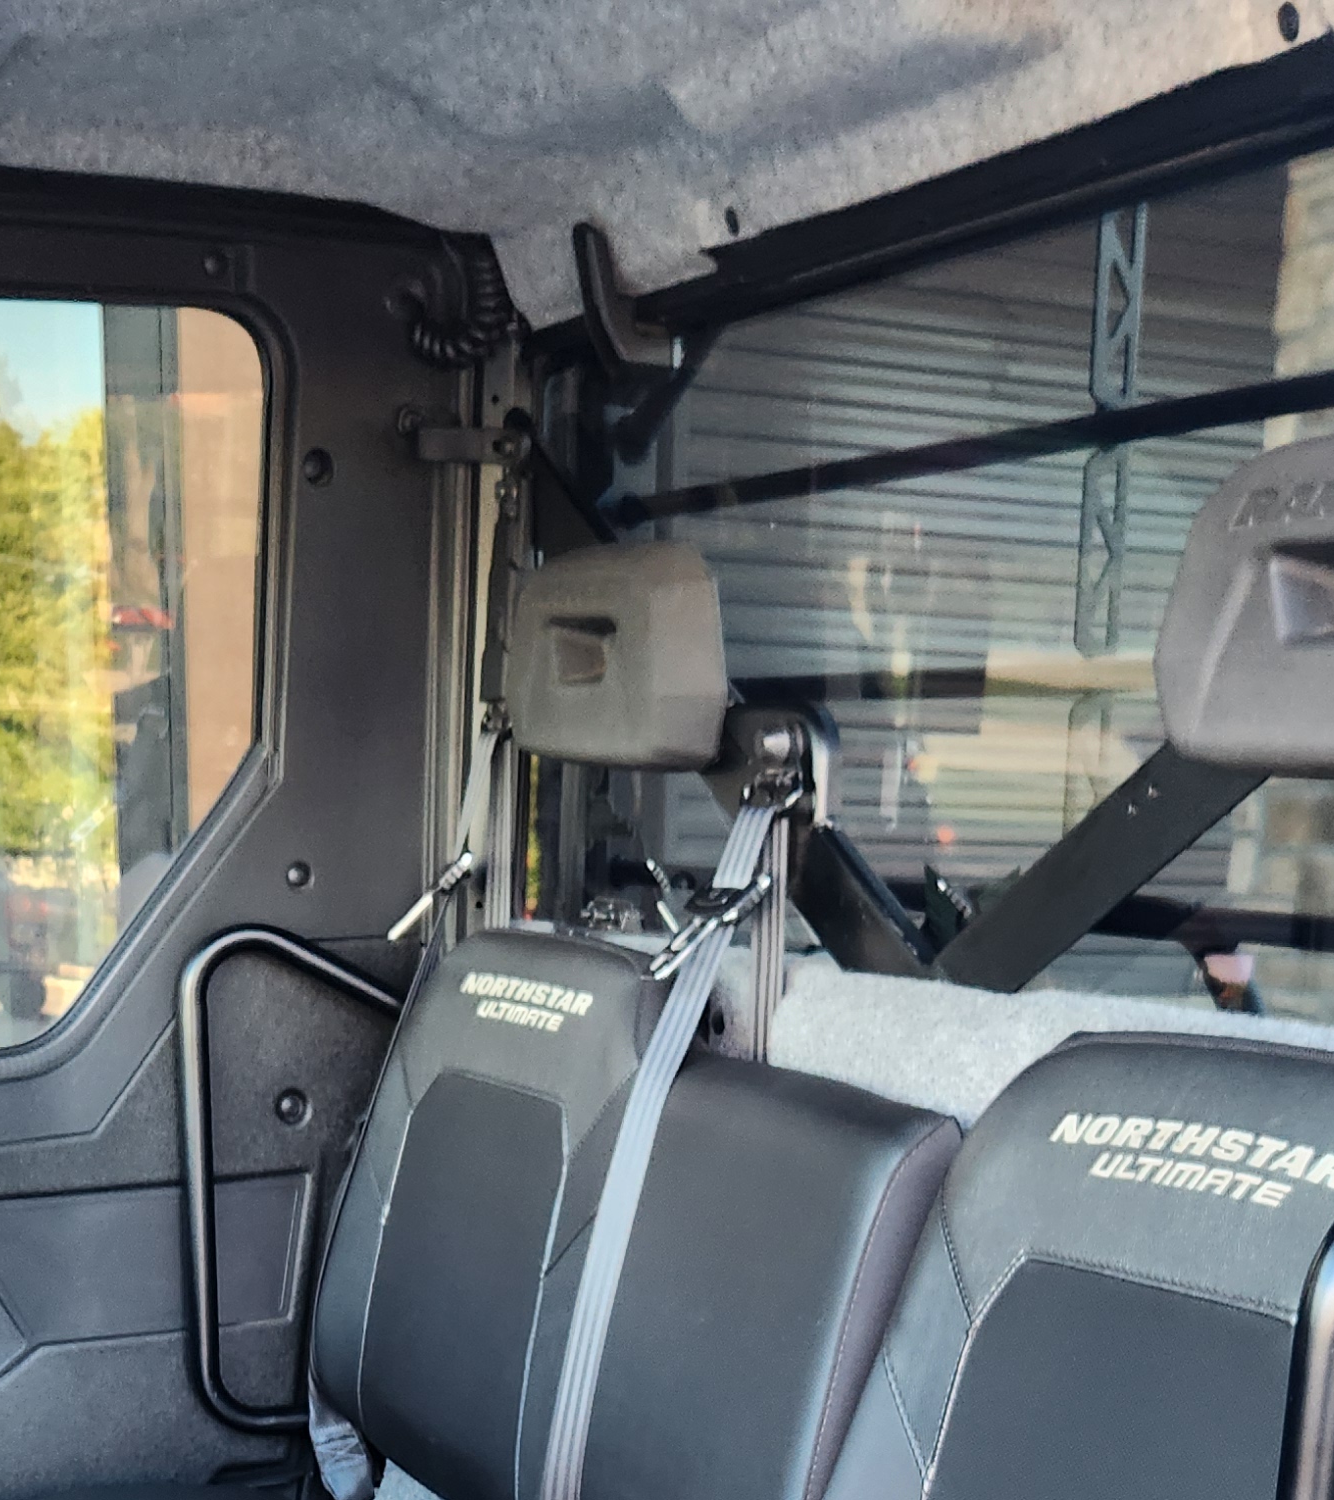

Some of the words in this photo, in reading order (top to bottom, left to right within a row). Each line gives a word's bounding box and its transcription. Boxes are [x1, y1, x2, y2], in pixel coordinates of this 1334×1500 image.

[459, 971, 595, 1017] NORTHSTAR
[475, 999, 565, 1033] ULTIMATE
[1088, 1151, 1296, 1208] ULTIMATE
